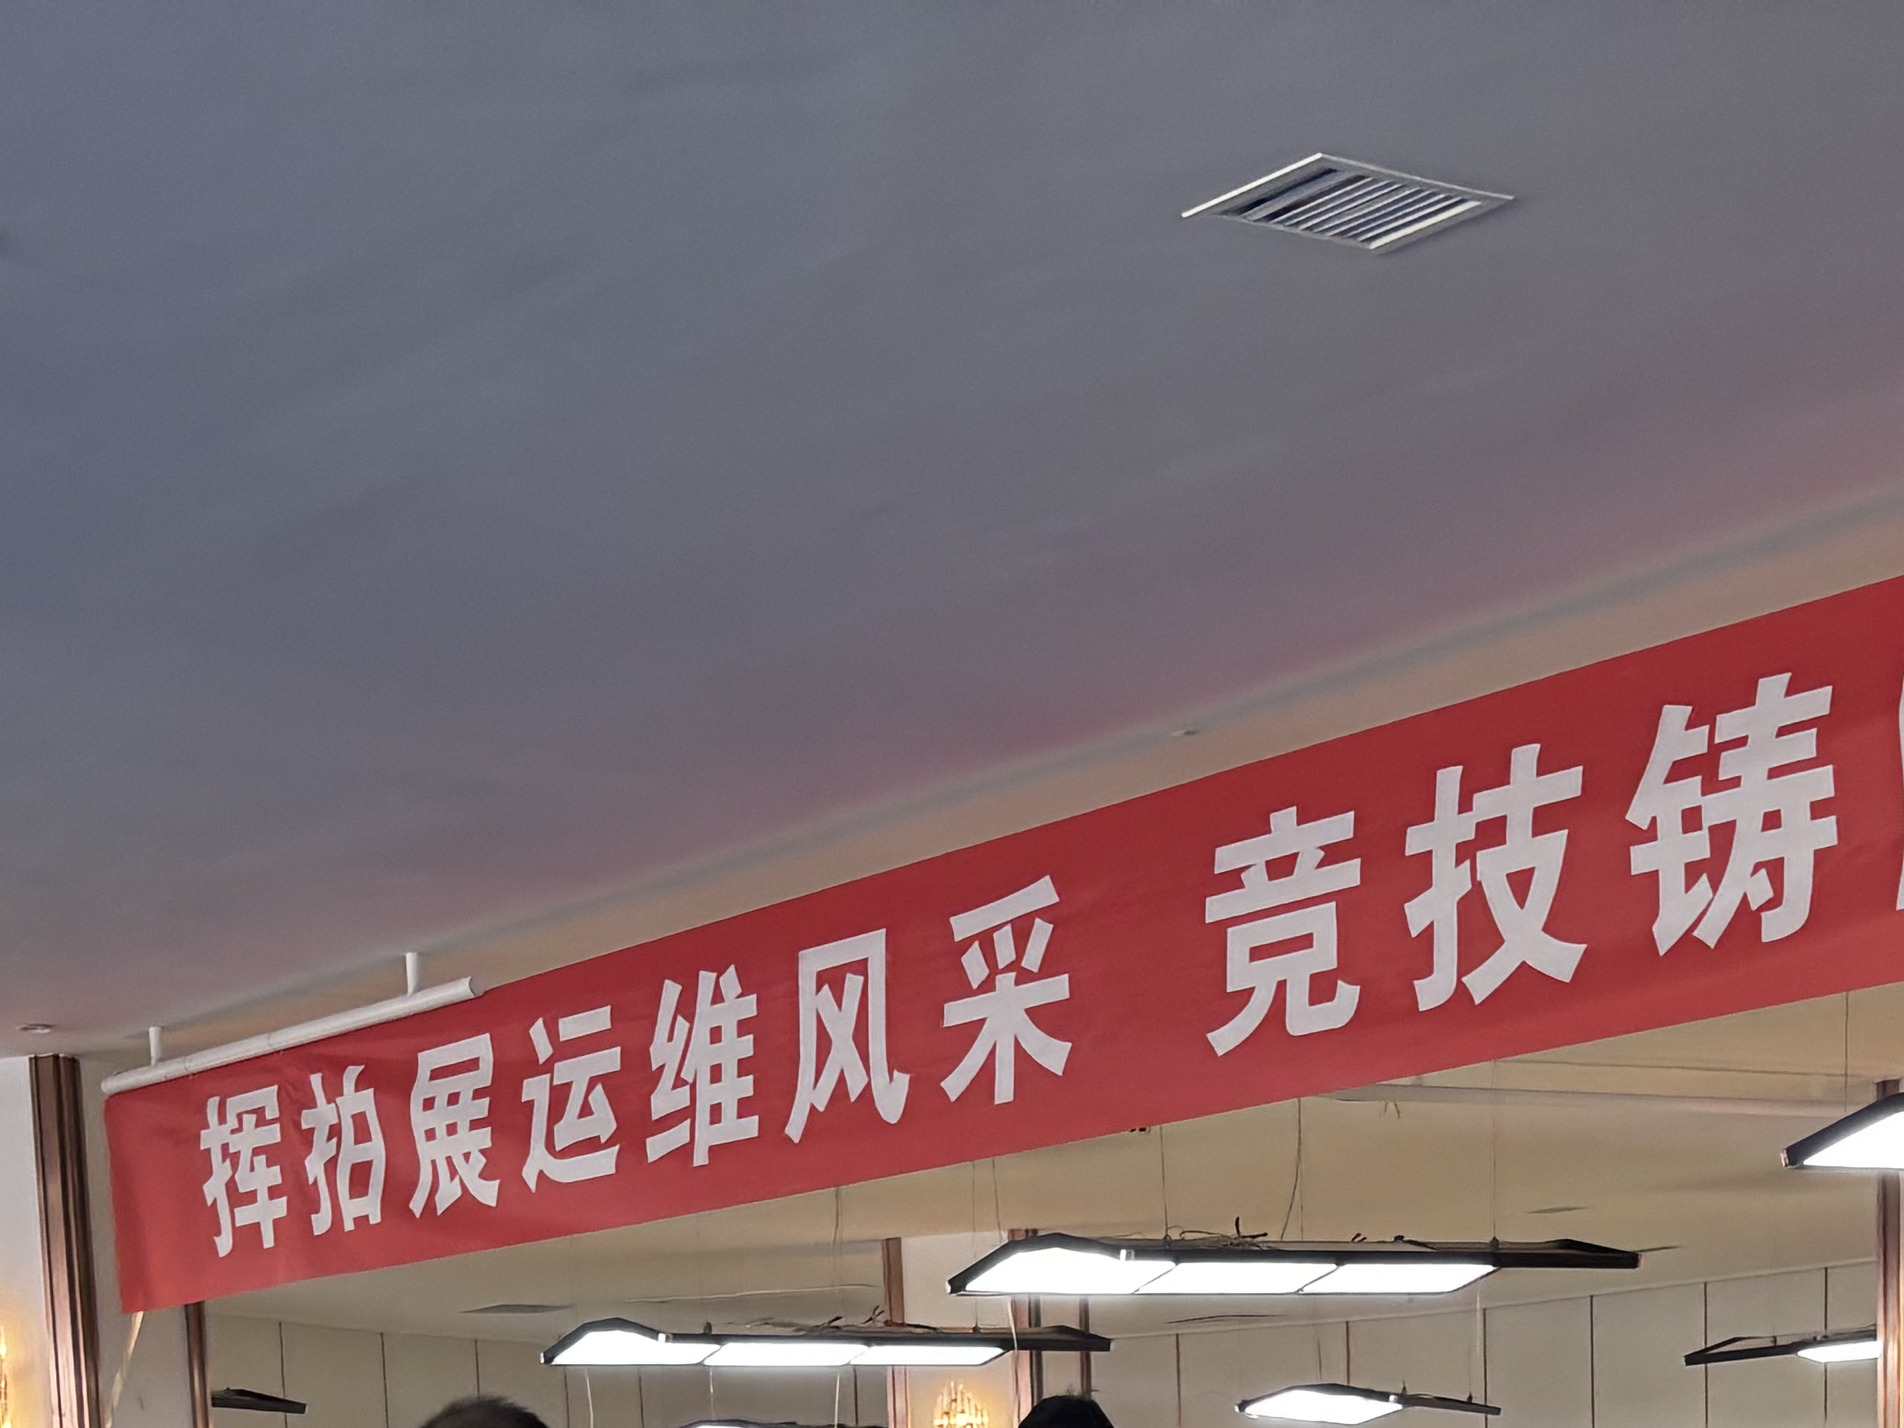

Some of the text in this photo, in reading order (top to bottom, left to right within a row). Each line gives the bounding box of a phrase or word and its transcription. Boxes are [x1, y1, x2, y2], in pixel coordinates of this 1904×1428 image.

[199, 874, 1074, 1258] 挥拍展运维风采
